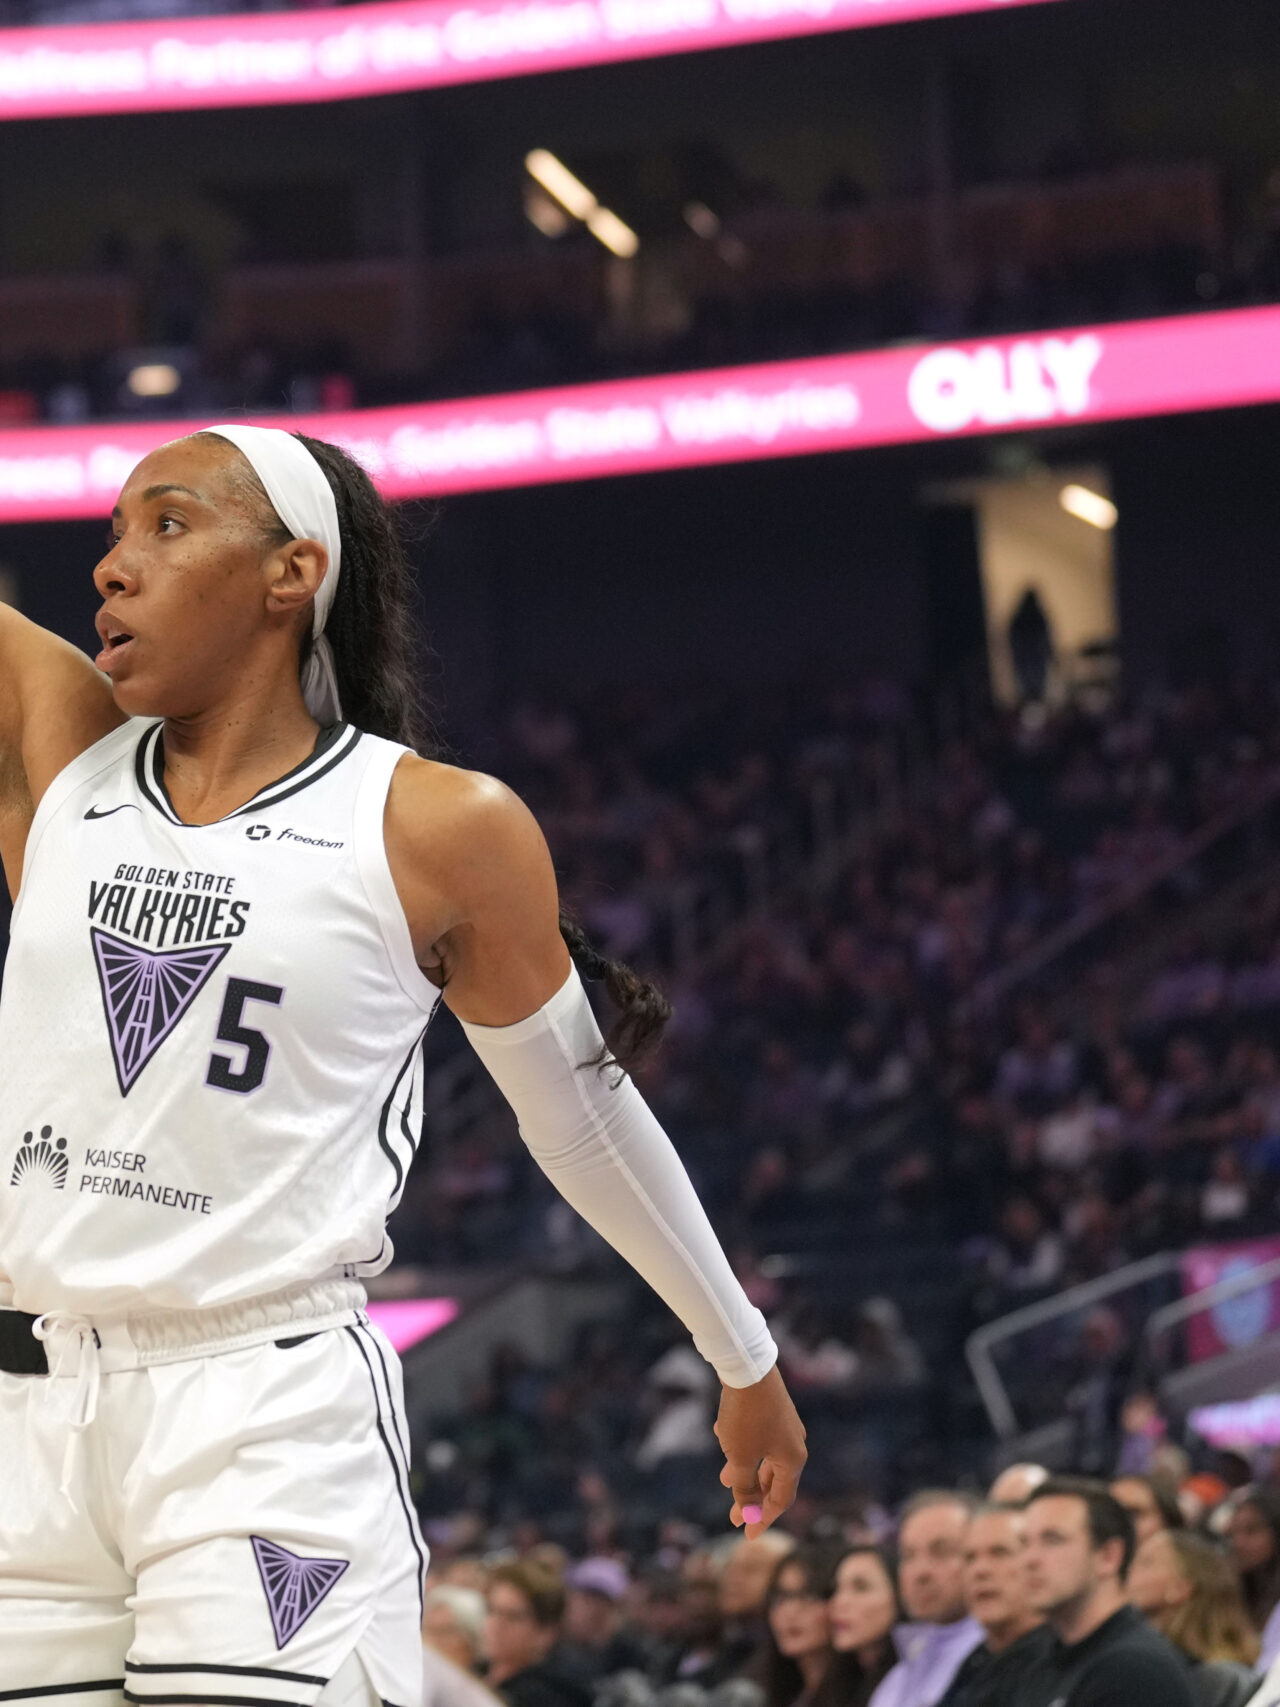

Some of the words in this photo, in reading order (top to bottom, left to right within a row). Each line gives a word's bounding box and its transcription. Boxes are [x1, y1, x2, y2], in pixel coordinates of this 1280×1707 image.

[909, 338, 1100, 430] OLLY
[276, 827, 344, 850] freedom
[113, 863, 179, 888] GOLDEN
[181, 871, 236, 895] STATE
[87, 880, 251, 948] VALKYRIES
[204, 975, 286, 1097] 5
[84, 1148, 147, 1173] KAISER
[79, 1174, 213, 1215] PERMANENTE
